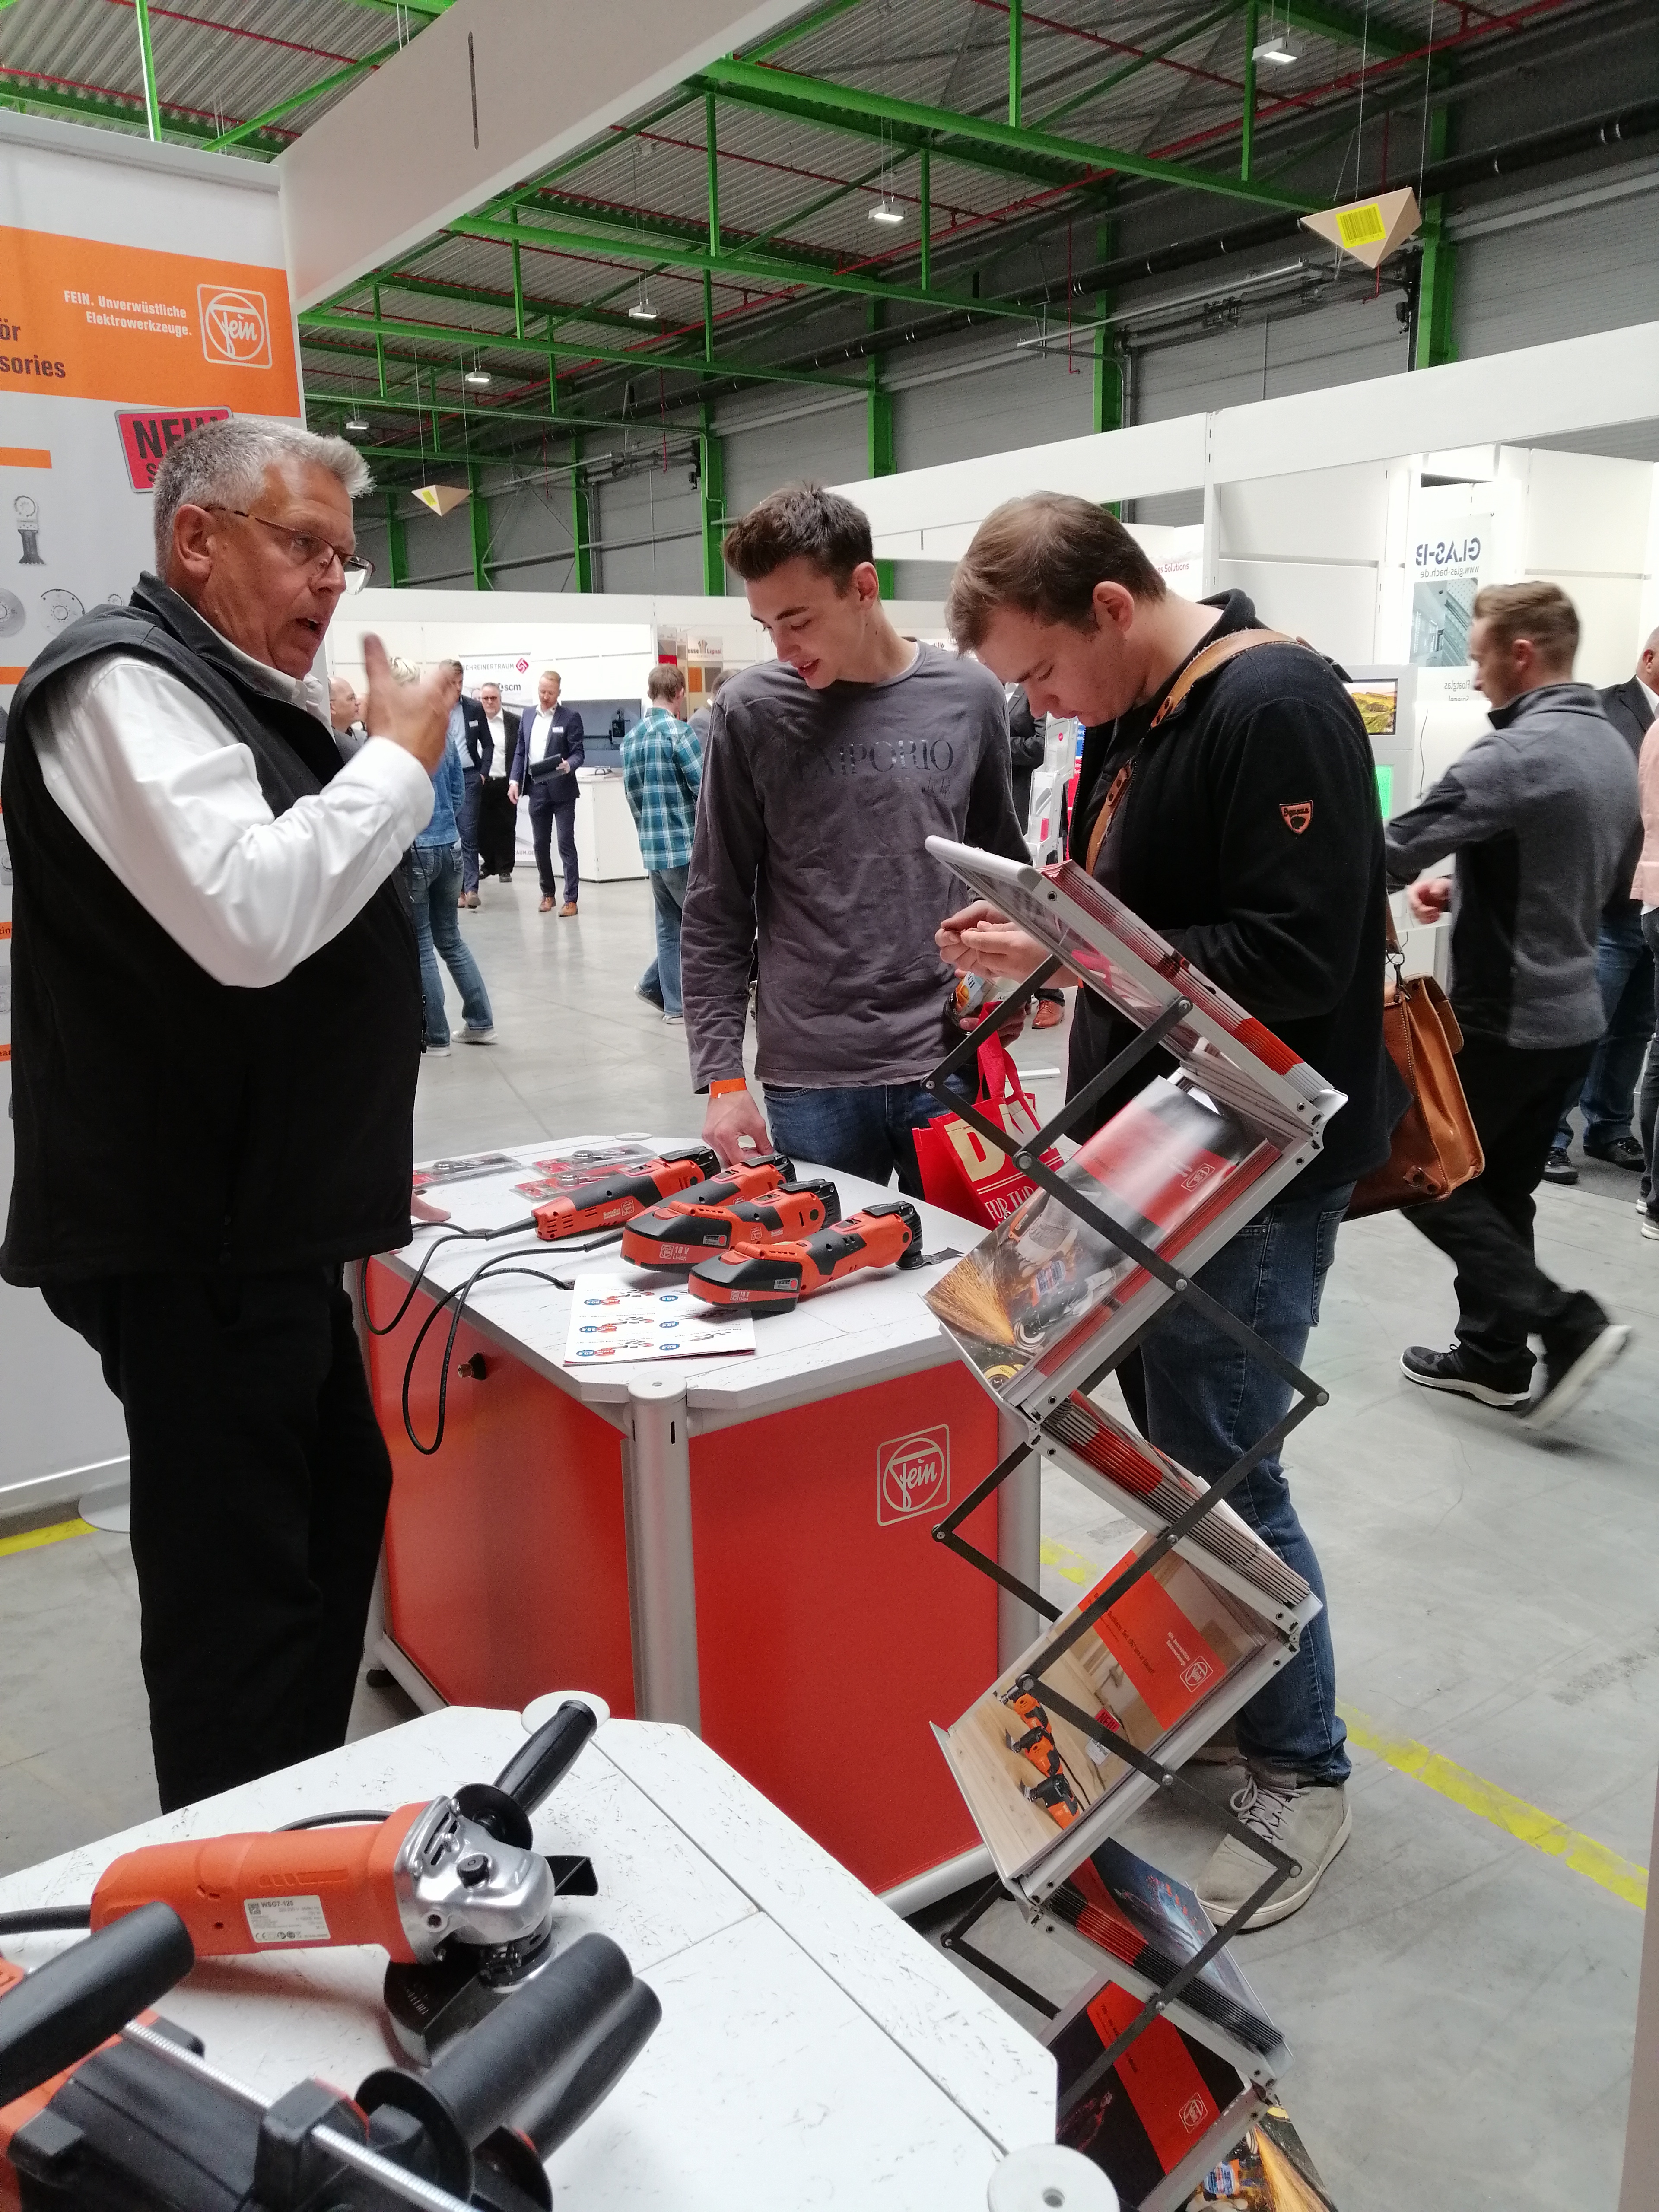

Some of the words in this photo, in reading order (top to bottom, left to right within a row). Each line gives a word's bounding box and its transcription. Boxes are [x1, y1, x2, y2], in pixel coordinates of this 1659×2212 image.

[64, 290, 94, 306] FEIN.
[98, 295, 186, 318] Unverwüstliche
[86, 311, 192, 337] Elektrowerkzeuge.
[1164, 562, 1189, 573] Solutions
